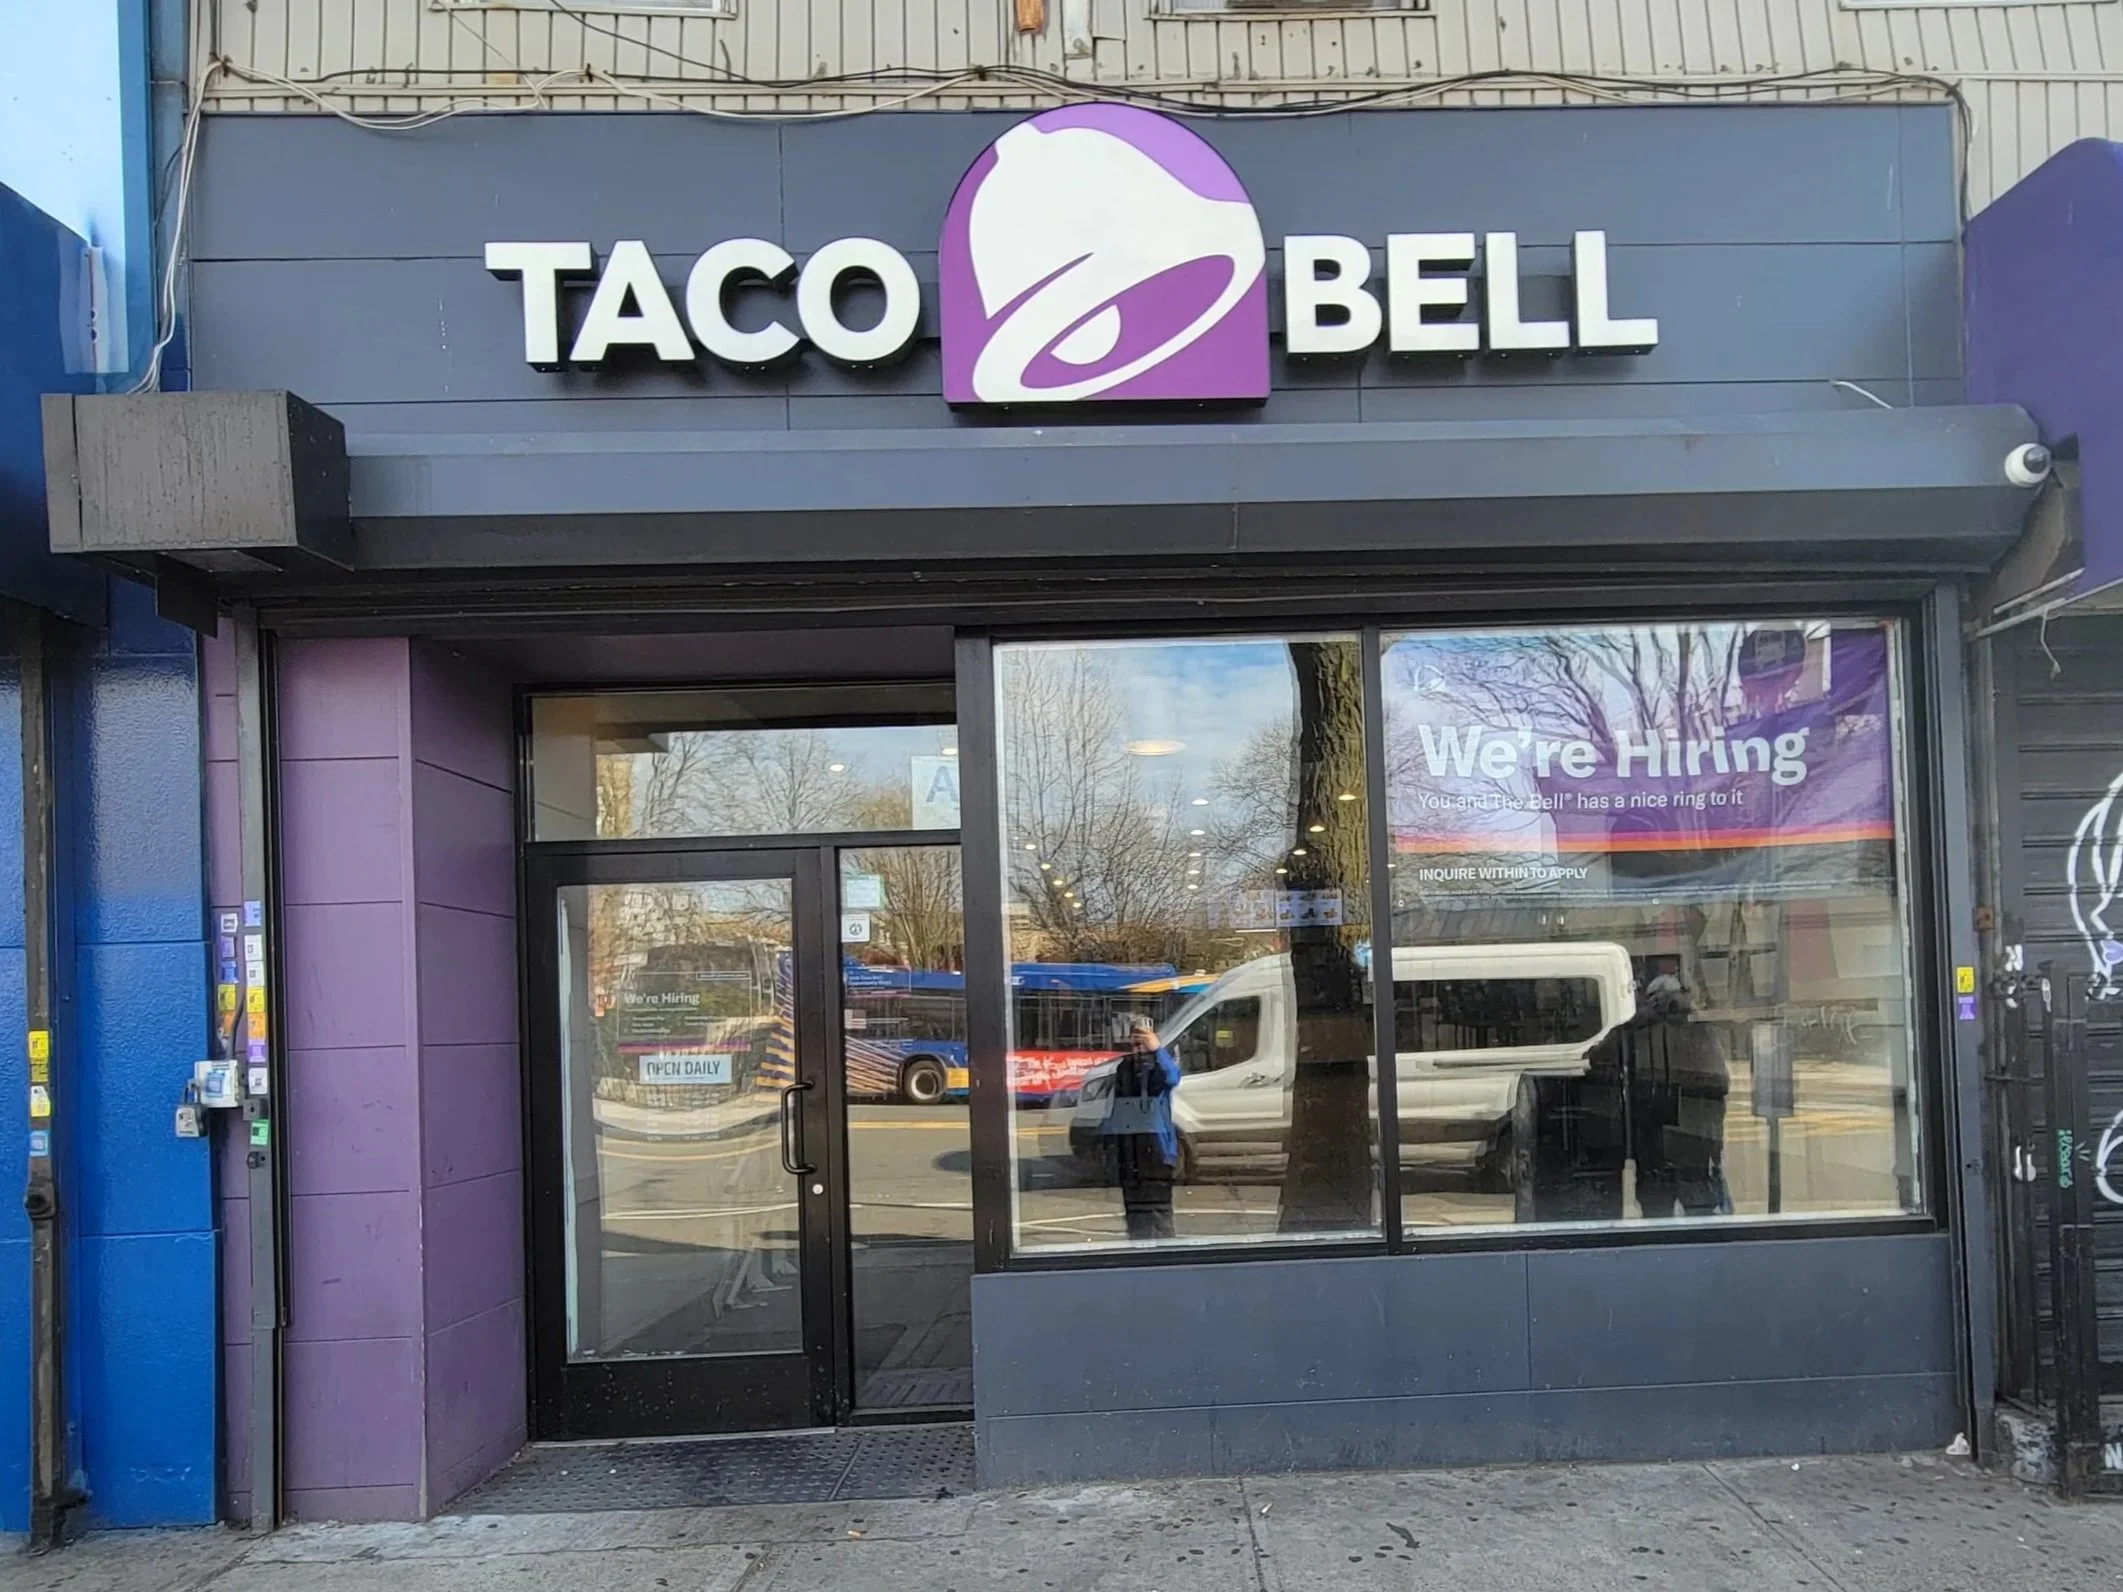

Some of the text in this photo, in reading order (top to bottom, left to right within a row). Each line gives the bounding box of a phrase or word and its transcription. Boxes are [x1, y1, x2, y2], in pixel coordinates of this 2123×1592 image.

[484, 229, 1659, 364] TACO BELL
[1418, 724, 1810, 786] We're Hiring
[926, 764, 959, 804] A
[1419, 793, 1451, 809] You
[1456, 793, 1488, 810] and
[1493, 793, 1525, 810] The
[1577, 792, 1609, 809] has
[1614, 795, 1626, 809] a
[1630, 791, 1668, 808] nice
[1673, 790, 1706, 811] ring
[1711, 789, 1727, 806] to
[1731, 788, 1744, 805] it
[1419, 866, 1588, 882] INQUIRE WITHIN TO APPLY
[661, 991, 700, 1007] Hiring
[646, 1060, 721, 1076] OPEN DAILY
